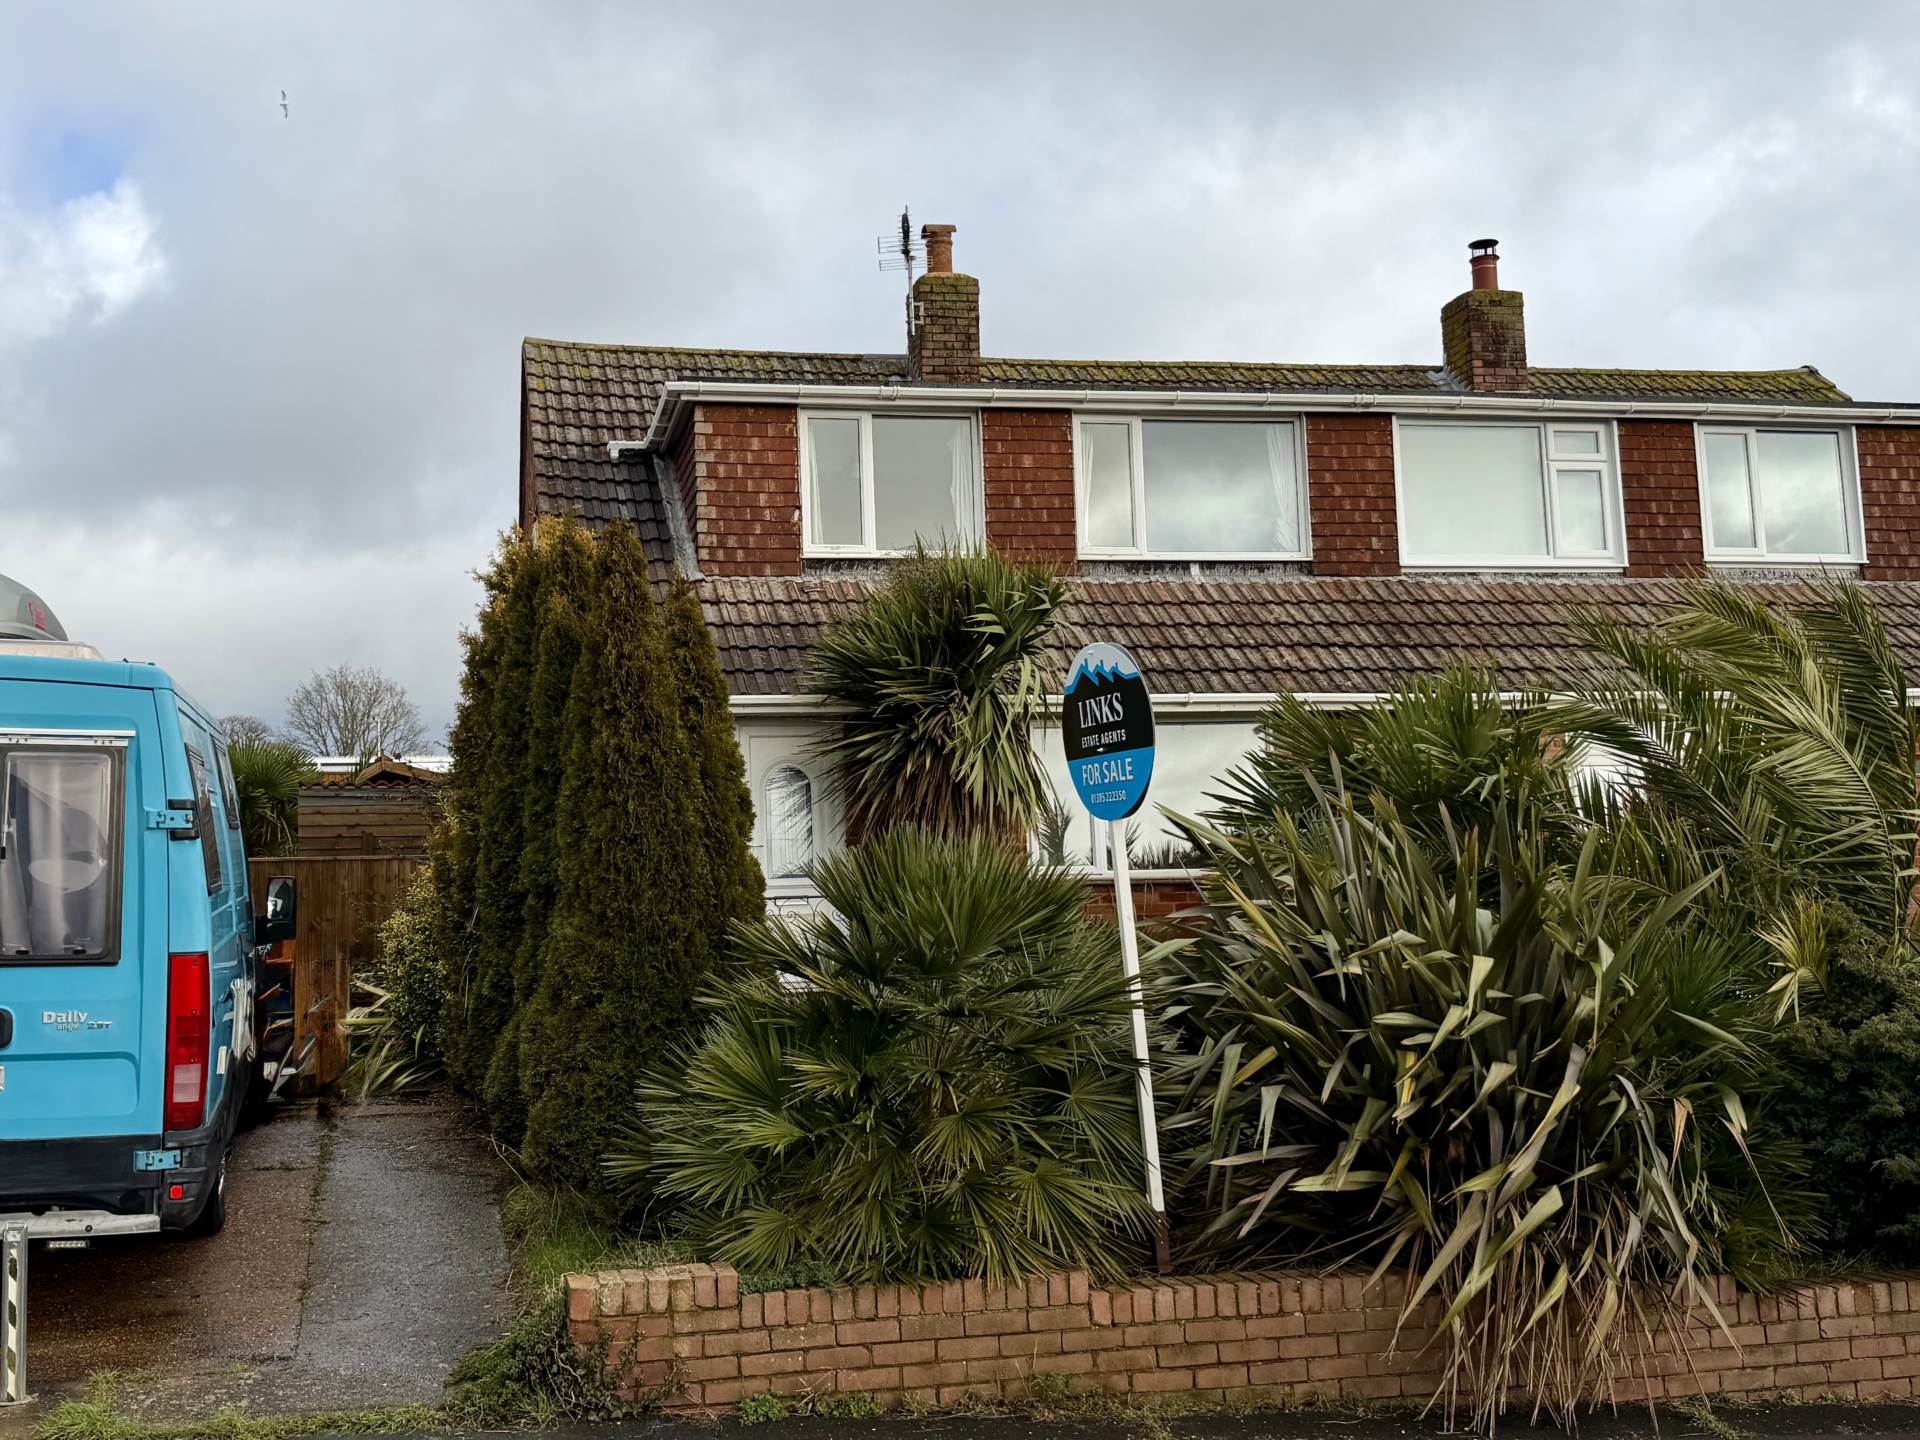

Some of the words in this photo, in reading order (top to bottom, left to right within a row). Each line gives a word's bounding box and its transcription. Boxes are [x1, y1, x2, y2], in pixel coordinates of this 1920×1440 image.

[1078, 692, 1124, 729] LINKS
[1081, 734, 1100, 748] ESTATE
[1100, 729, 1127, 745] AGENTS
[1081, 762, 1101, 786] FOR
[1102, 757, 1134, 784] SALE
[42, 1010, 88, 1024] Daily
